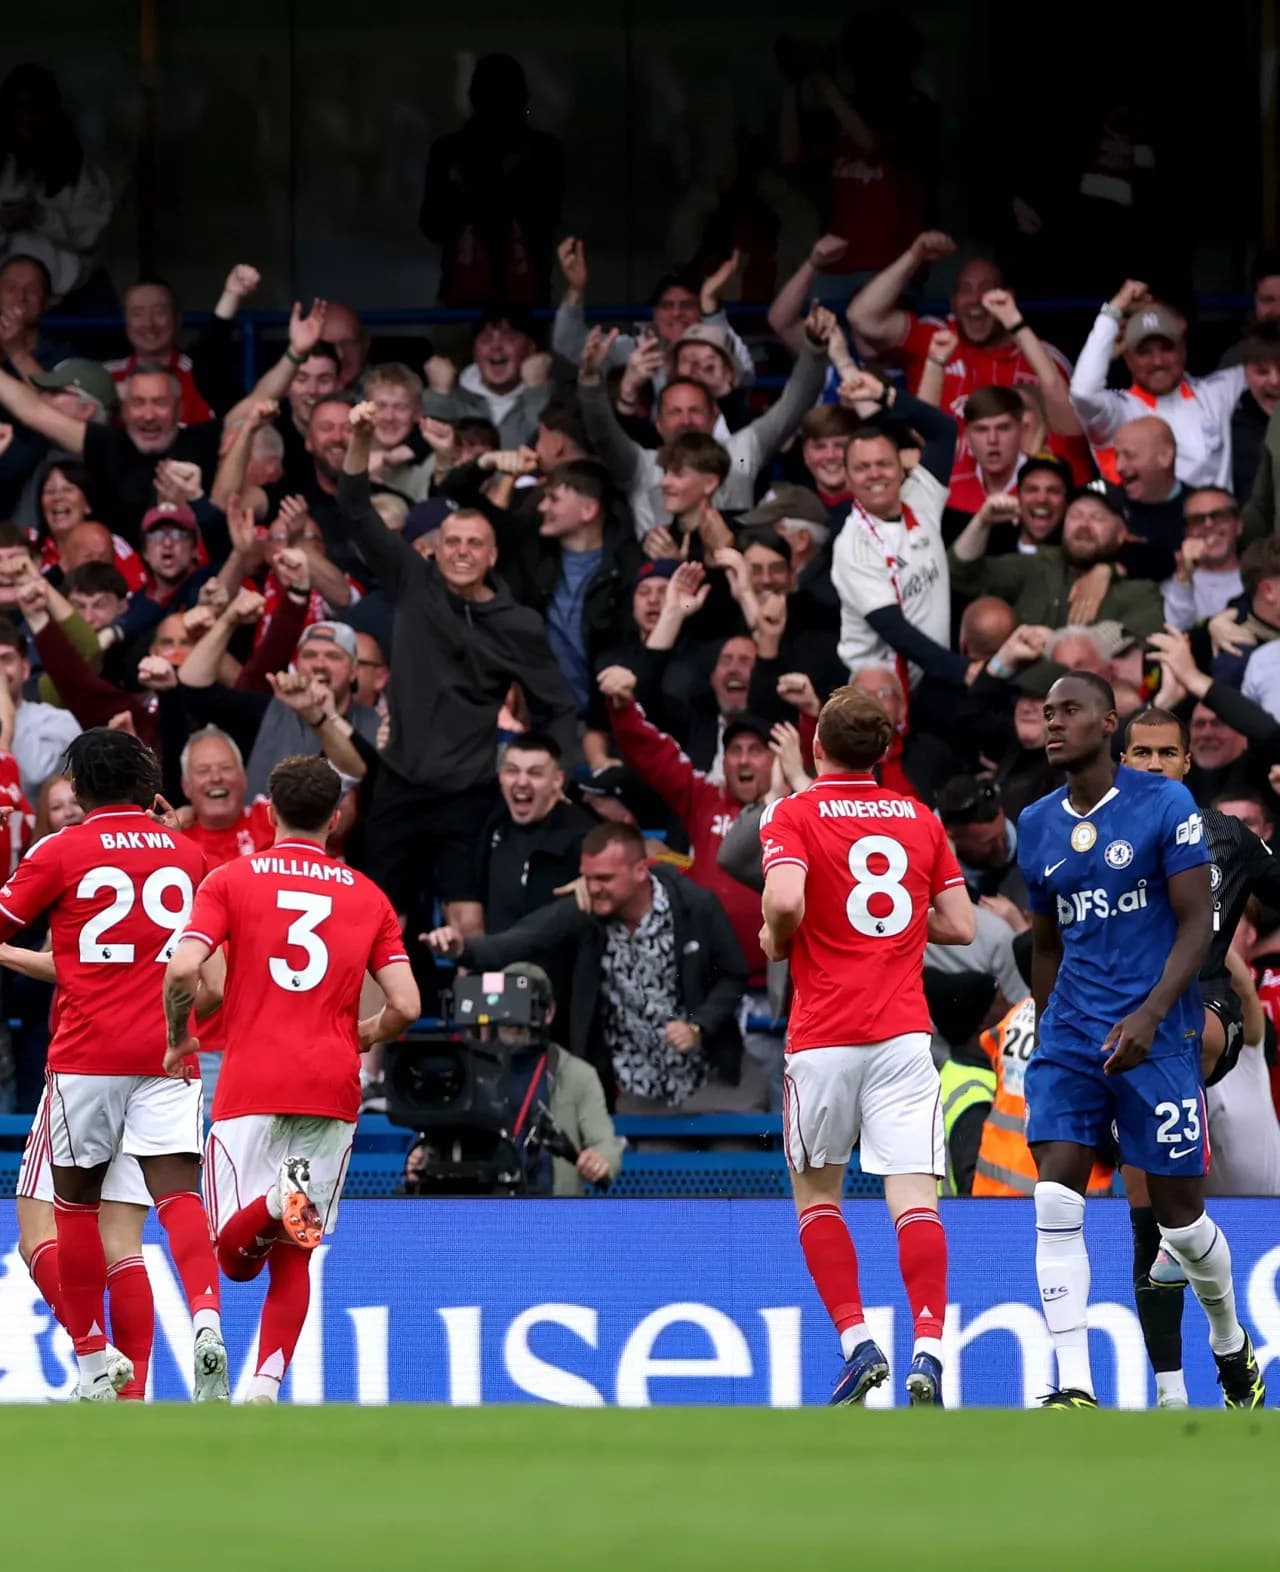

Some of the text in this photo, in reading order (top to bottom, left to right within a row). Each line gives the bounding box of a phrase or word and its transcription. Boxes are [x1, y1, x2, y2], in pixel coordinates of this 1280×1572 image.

[819, 799, 916, 819] ANDERSON
[100, 831, 176, 850] BAKWA
[250, 857, 355, 886] WILLIAMS
[846, 835, 913, 937] 8
[76, 866, 194, 963] 29
[269, 889, 332, 992] 3
[1004, 1028, 1035, 1062] 20
[1155, 1098, 1200, 1143] 23
[1042, 1286, 1069, 1295] CFC
